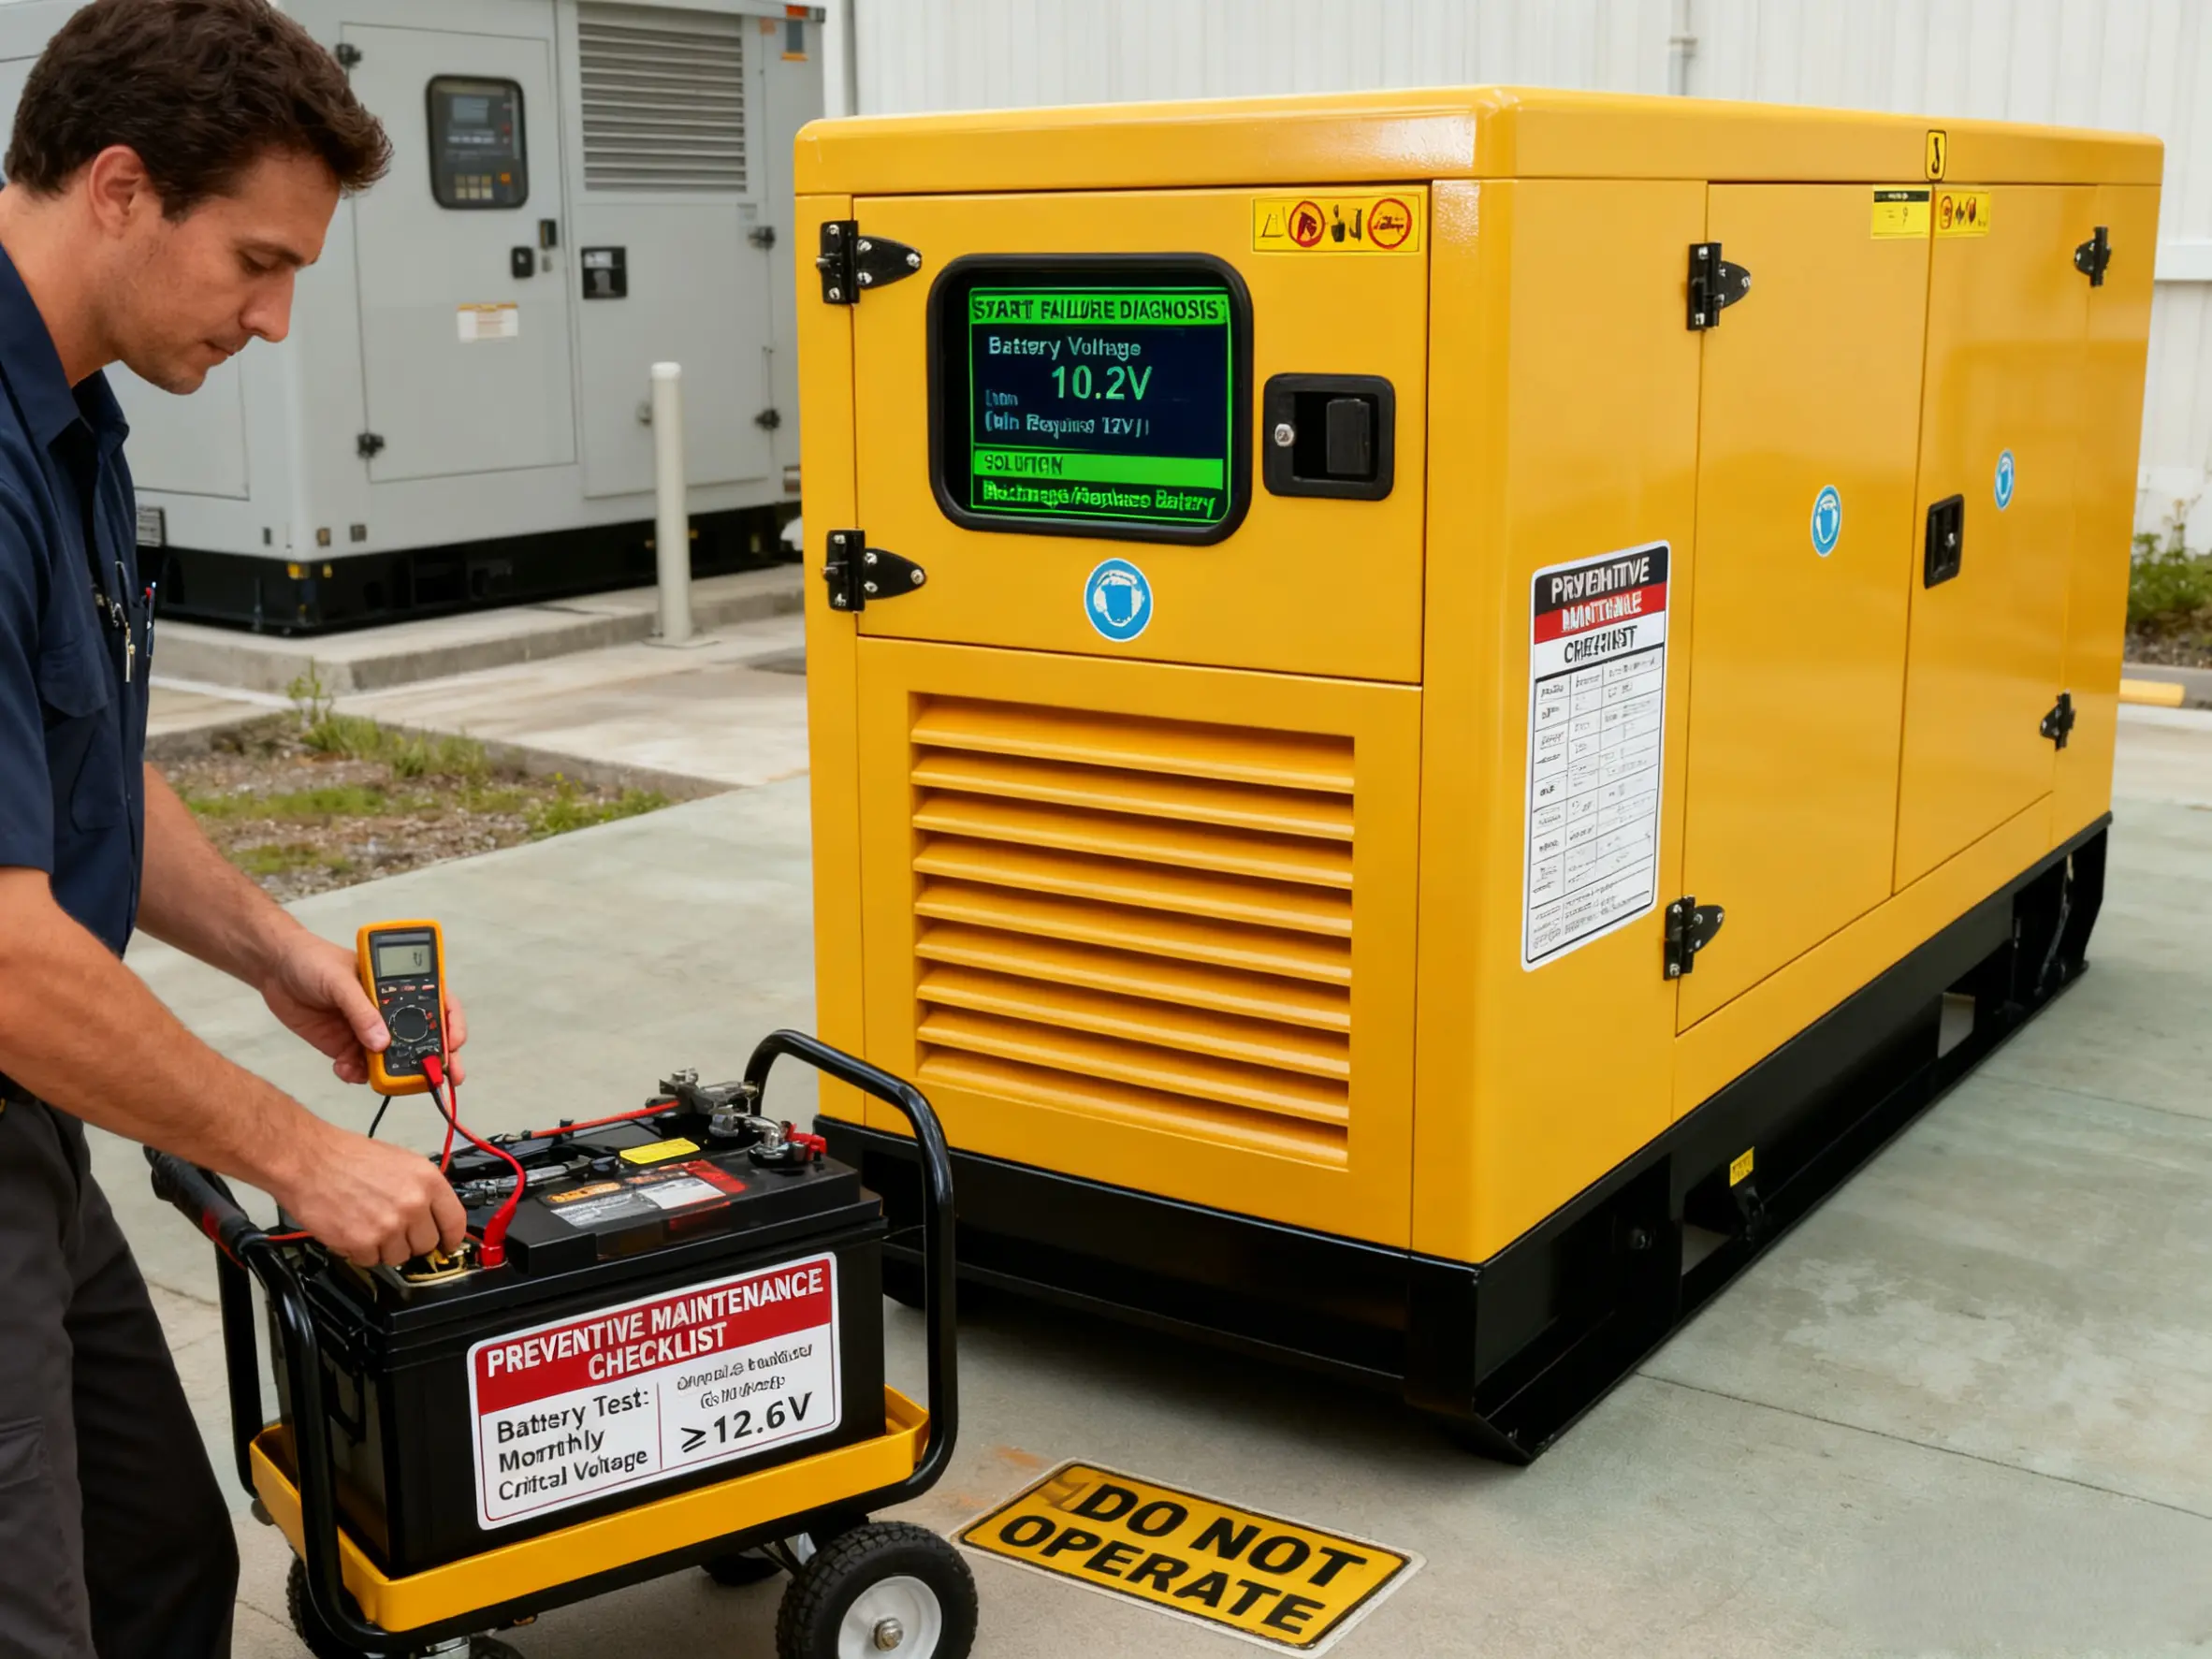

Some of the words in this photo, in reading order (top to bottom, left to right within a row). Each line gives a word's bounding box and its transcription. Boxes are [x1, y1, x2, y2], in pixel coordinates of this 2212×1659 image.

[1051, 364, 1153, 400] 10.2V
[486, 1311, 645, 1377] PREVENTIVE
[651, 1267, 824, 1335] MAINTENANCE
[588, 1322, 728, 1381] CHECKLIST
[497, 1405, 587, 1444] Battery
[592, 1387, 650, 1418] Test:
[997, 1515, 1328, 1636] OPERATE
[1073, 1481, 1189, 1538] DO
[1188, 1516, 1368, 1588] NOT
